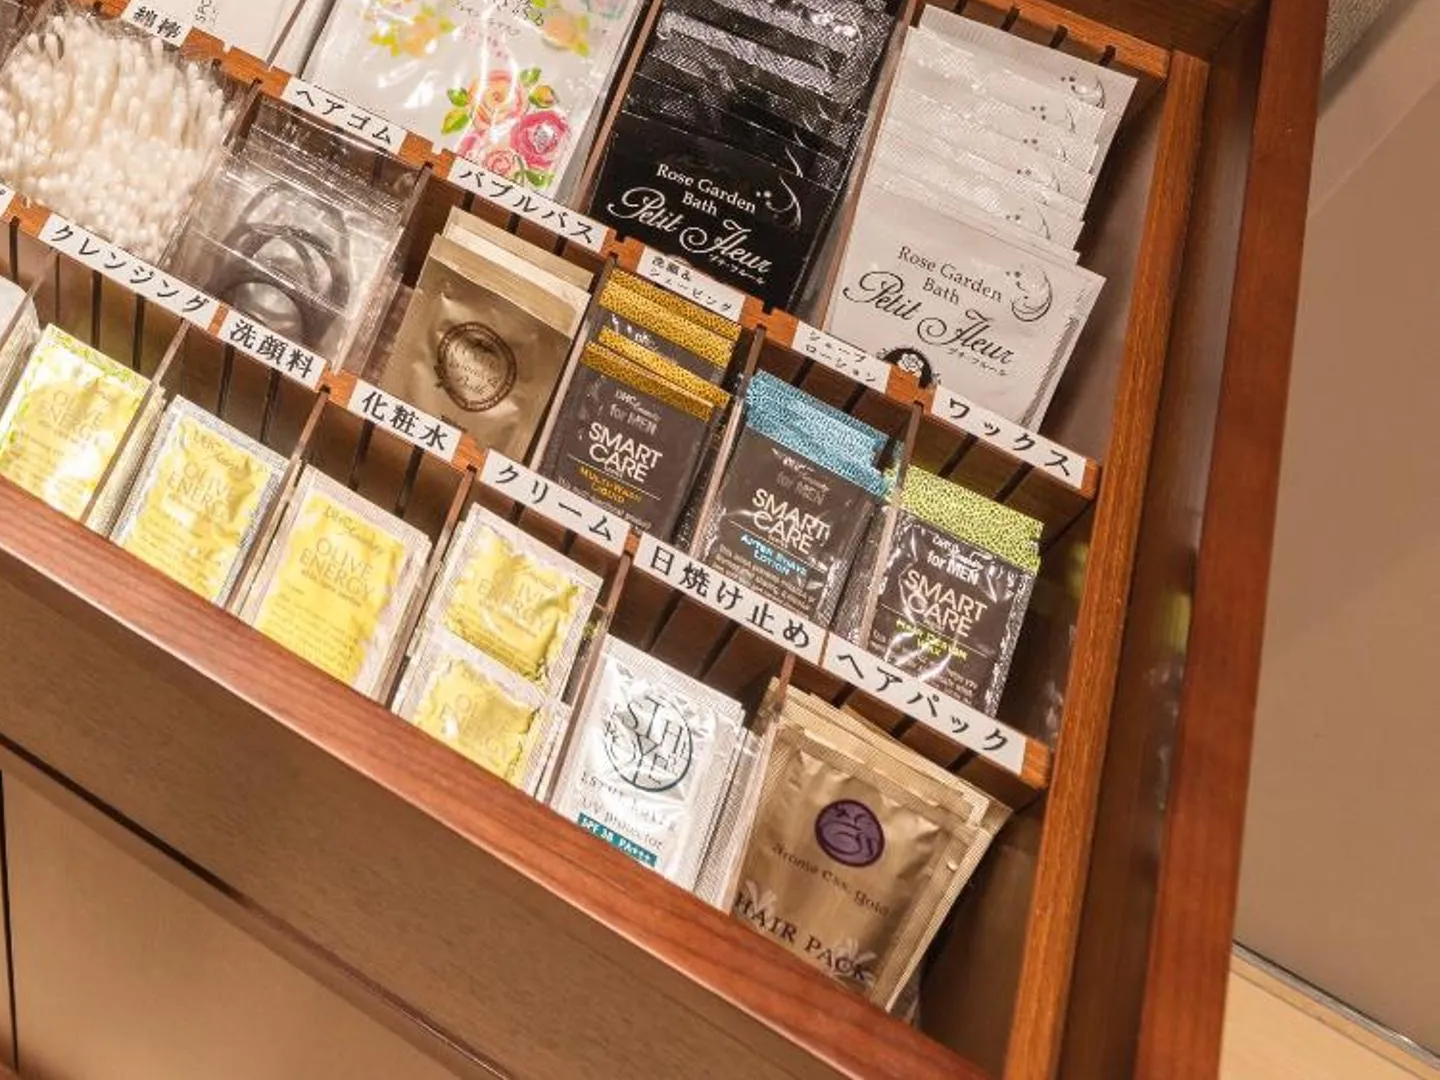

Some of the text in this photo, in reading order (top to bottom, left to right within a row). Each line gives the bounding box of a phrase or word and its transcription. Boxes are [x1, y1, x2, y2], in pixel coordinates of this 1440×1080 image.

[459, 170, 593, 244] バブルバス
[656, 163, 757, 215] Rose Garden
[682, 191, 718, 217] Bath
[607, 187, 773, 273] Petit Fleur
[54, 225, 210, 313] クレンジング
[897, 245, 1003, 304] Rose Garden
[922, 276, 961, 305] Bath
[842, 271, 1016, 365] Petit Fleur
[229, 318, 313, 378] 洗顔料
[362, 392, 445, 451] 化粧水
[589, 422, 663, 468] SMART
[949, 398, 1070, 476] ワックス
[589, 444, 649, 483] CARE
[495, 465, 613, 541] クリーム
[752, 488, 826, 541] SMART
[753, 510, 813, 555] CARE
[650, 546, 810, 648] 日焼け止め
[904, 570, 988, 621] SMART
[927, 551, 980, 586] for MEN
[908, 592, 973, 638] CARE
[837, 653, 1008, 752] ヘアパック
[772, 842, 818, 874] aroma
[855, 890, 891, 917] gold
[735, 890, 866, 982] HAIR PACK
